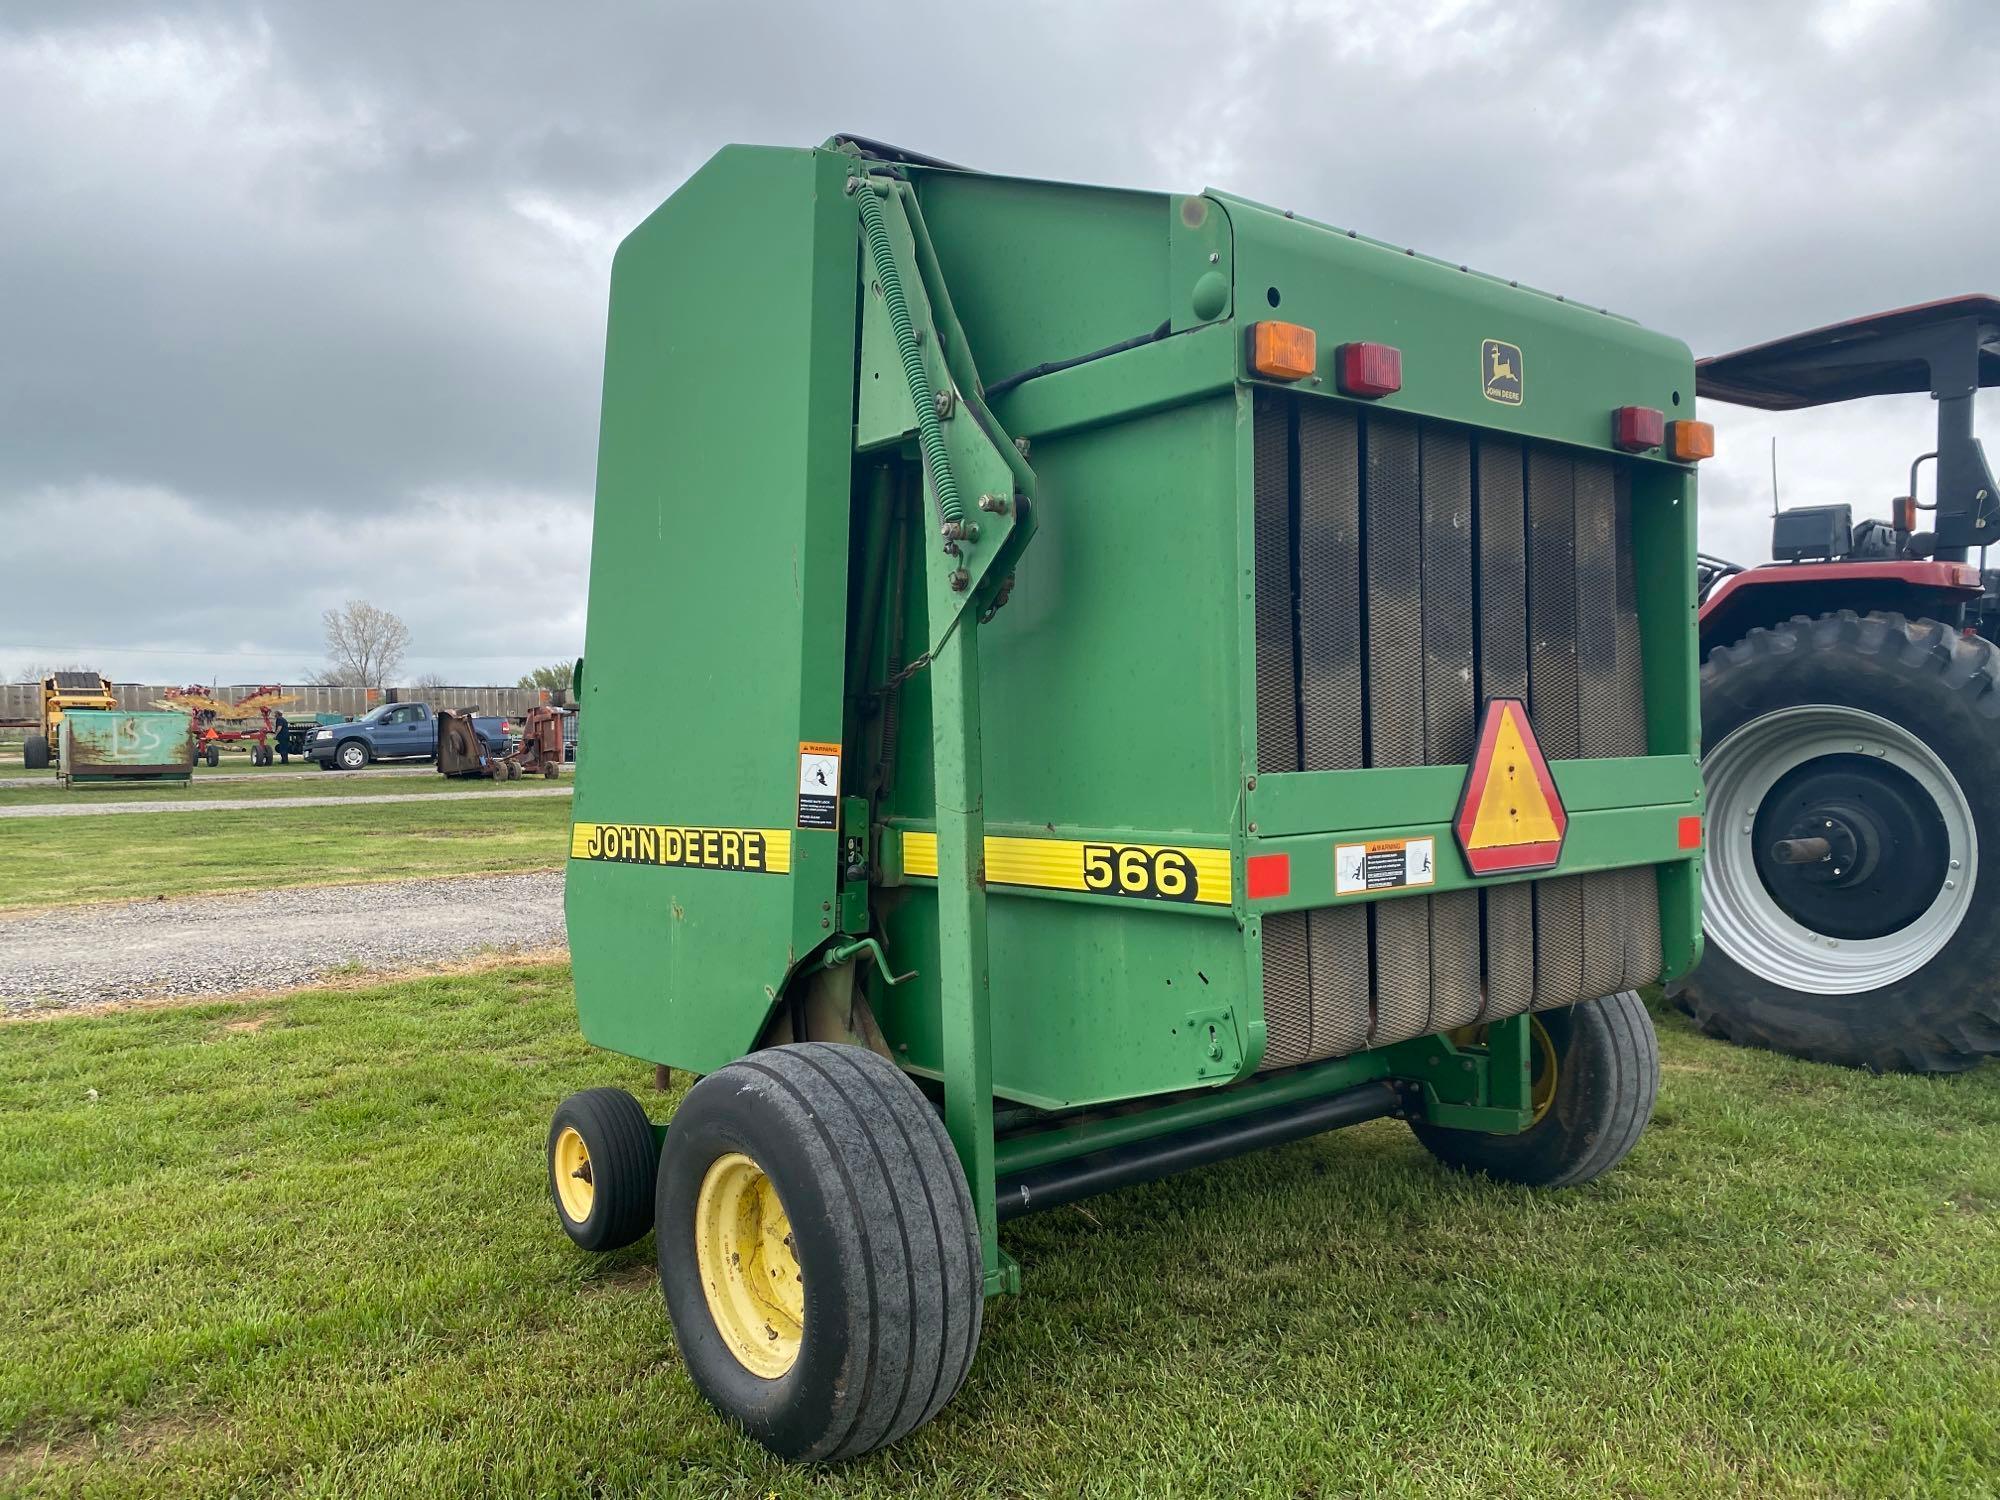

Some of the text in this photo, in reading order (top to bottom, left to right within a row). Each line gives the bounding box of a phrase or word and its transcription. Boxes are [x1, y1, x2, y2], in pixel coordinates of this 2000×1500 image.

[1487, 387, 1519, 400] JOHN DEERE
[809, 745, 838, 753] WARNING
[587, 826, 766, 872] JOHN DEERE
[1084, 845, 1196, 900] 566
